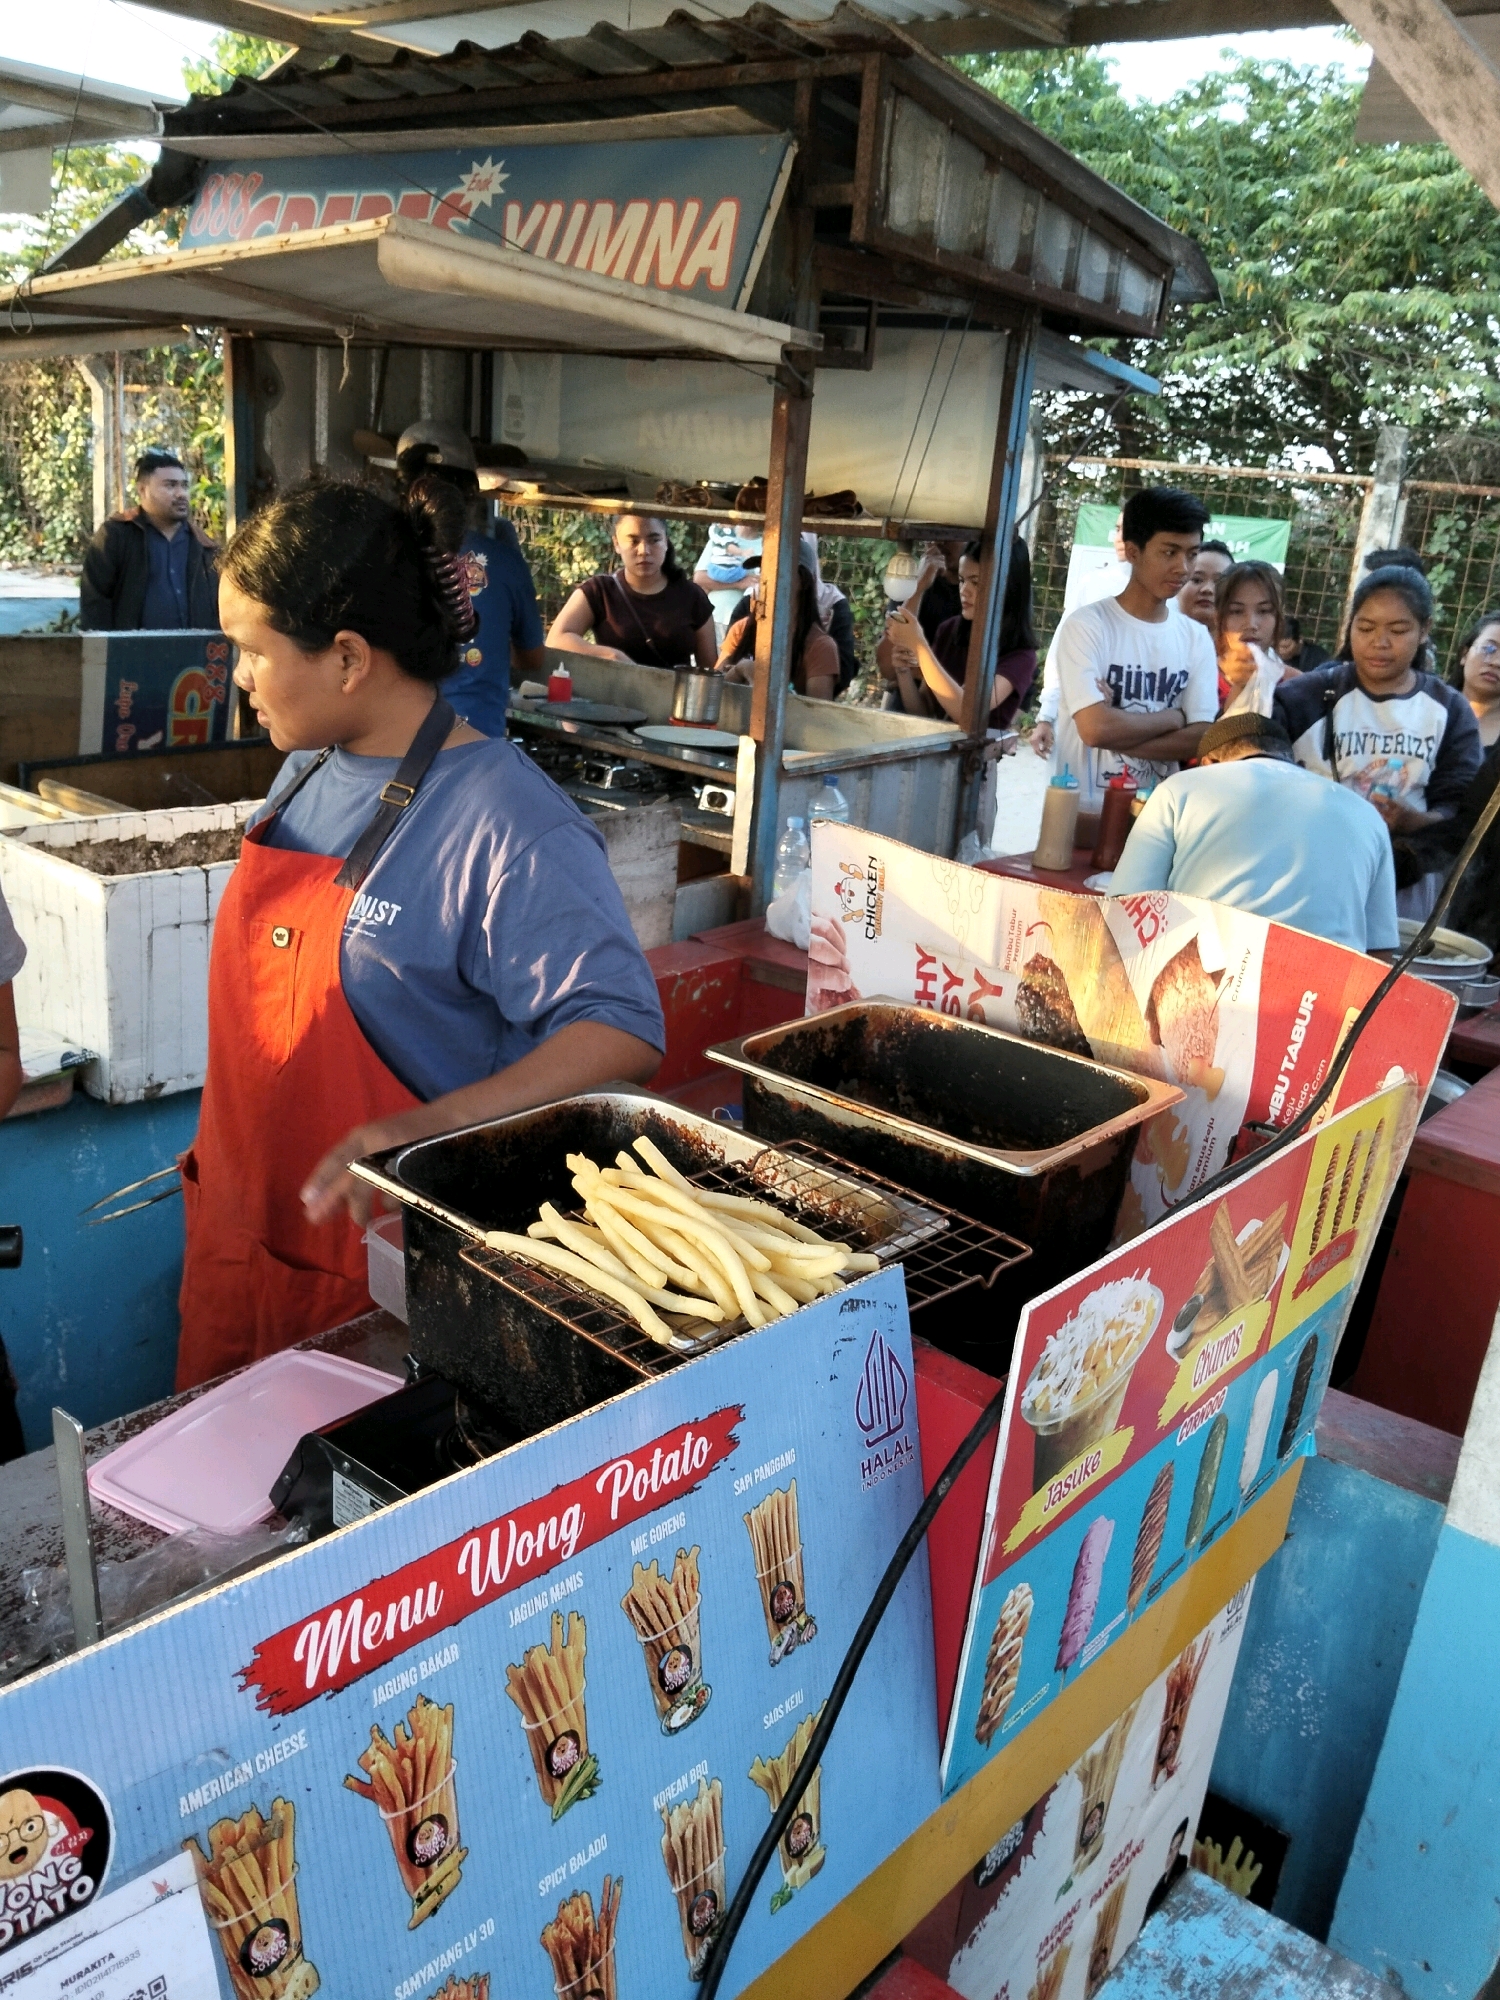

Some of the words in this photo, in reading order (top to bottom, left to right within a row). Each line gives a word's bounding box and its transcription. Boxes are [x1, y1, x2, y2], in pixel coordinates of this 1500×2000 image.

[191, 172, 263, 236] 888
[203, 642, 230, 704] 888
[865, 854, 878, 940] CHICKEN
[1008, 908, 1017, 936] Tabur
[1012, 920, 1023, 962] Premium
[1004, 937, 1014, 971] Bumbu
[1231, 948, 1252, 1002] Crunchy
[1280, 990, 1318, 1072] TABUR
[1311, 1059, 1327, 1090] Corn
[1282, 1097, 1296, 1125] Keju
[1195, 1143, 1207, 1173] saus
[1203, 1117, 1215, 1143] keju
[1192, 1321, 1245, 1390] Churros
[733, 1475, 753, 1497] SAPI
[754, 1448, 796, 1483] PANGGANG
[860, 1435, 914, 1480] HALAL
[861, 1453, 915, 1492] INDONESIA
[630, 1534, 648, 1557] MIE
[649, 1511, 686, 1550] GORENG
[293, 1579, 444, 1689] Menu
[457, 1501, 586, 1598] Wong
[596, 1430, 713, 1521] Potato
[508, 1597, 549, 1629] JAGUNG
[550, 1571, 584, 1609] MANIS
[372, 1663, 419, 1708] JAGUNG
[419, 1643, 460, 1684] BAKAR
[785, 1689, 804, 1716] KEJU
[179, 1763, 253, 1818] AMERICAN
[255, 1729, 309, 1774] CHEESE
[653, 1772, 689, 1812] KOREAN
[538, 1862, 568, 1897] SPICY
[569, 1833, 608, 1875] BALADO
[464, 1929, 478, 1954] LV
[479, 1917, 495, 1941] 30
[60, 1952, 116, 1990] MURAKITA
